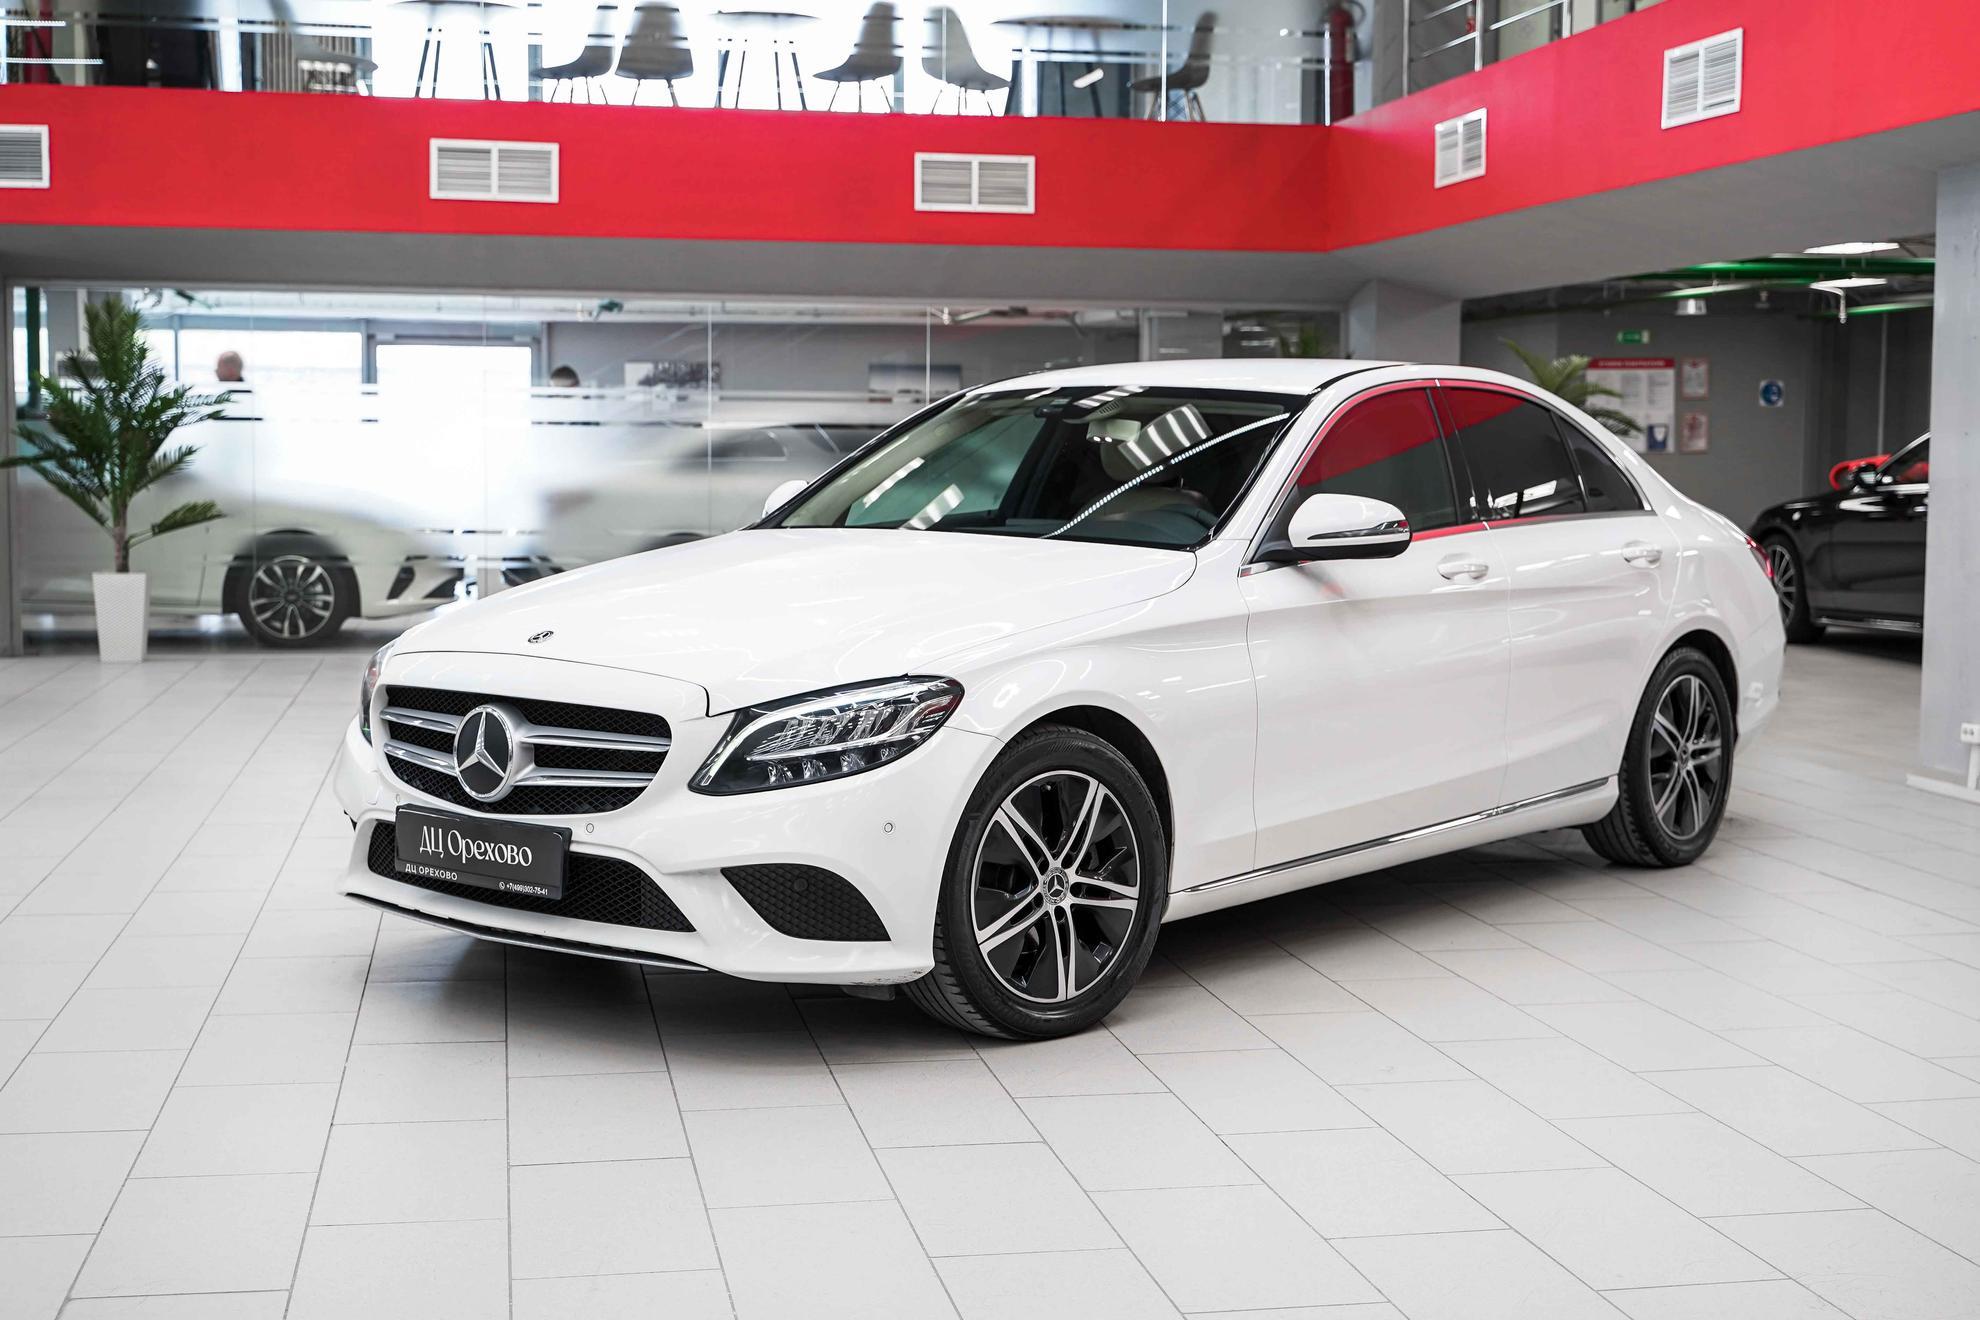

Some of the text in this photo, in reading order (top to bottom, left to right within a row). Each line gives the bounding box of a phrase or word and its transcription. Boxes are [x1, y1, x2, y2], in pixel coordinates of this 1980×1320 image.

[419, 825, 533, 867] ДЦ Орехово
[405, 863, 458, 881] ДЦ ОРЕХОВО
